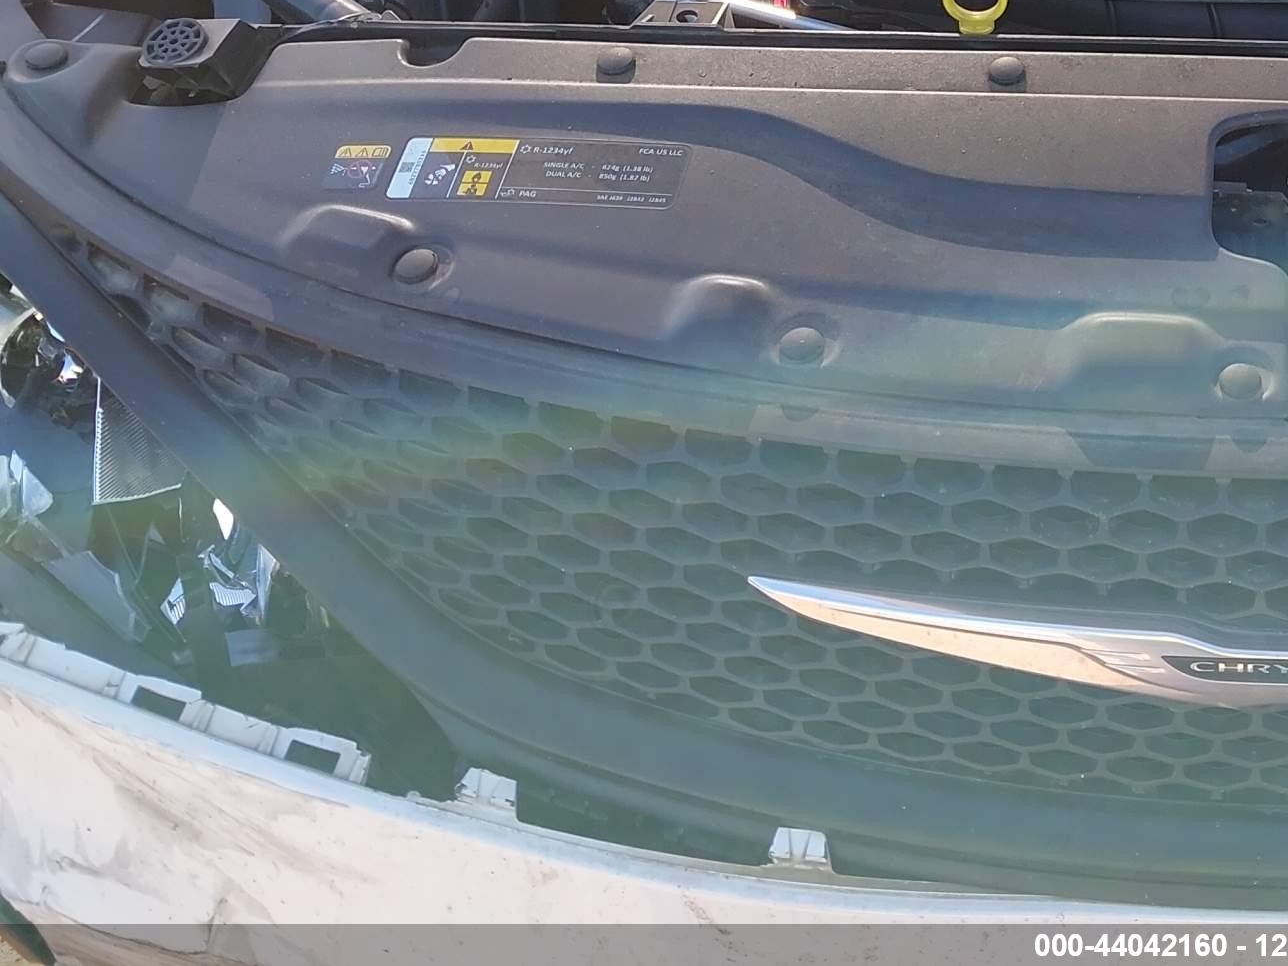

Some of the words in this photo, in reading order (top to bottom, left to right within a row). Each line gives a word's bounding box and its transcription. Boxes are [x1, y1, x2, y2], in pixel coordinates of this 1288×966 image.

[533, 146, 574, 155] R-1234yf
[638, 147, 654, 155] FCA
[656, 148, 667, 156] US
[543, 161, 569, 169] SINGLE
[570, 162, 585, 170] A/C
[642, 165, 654, 173] lb)
[545, 170, 566, 178] DUAL
[639, 174, 650, 183] lb)
[518, 190, 537, 198] PAG
